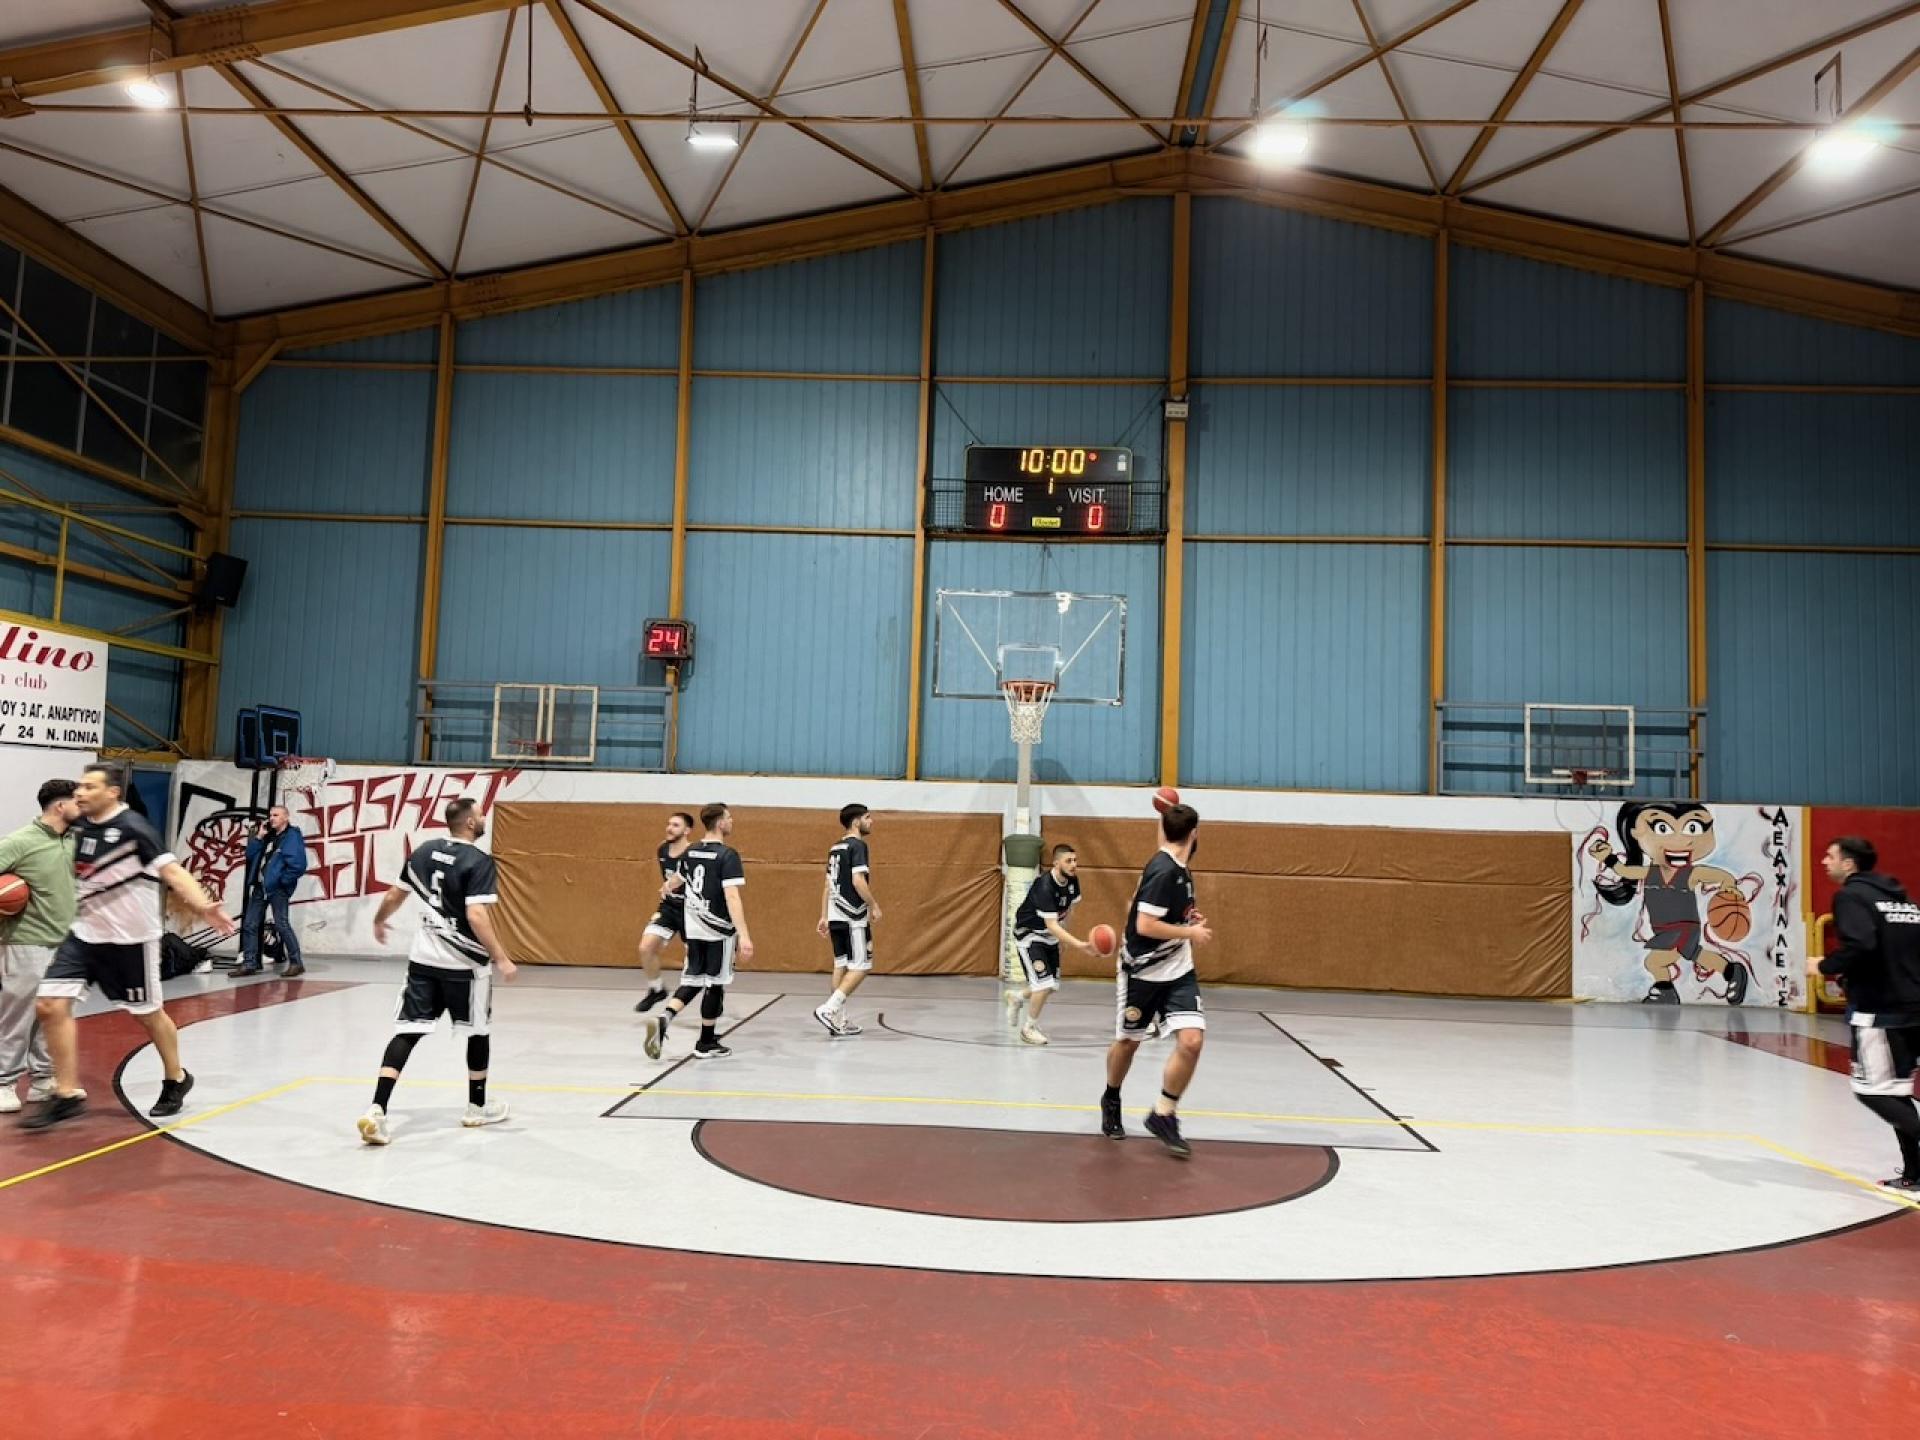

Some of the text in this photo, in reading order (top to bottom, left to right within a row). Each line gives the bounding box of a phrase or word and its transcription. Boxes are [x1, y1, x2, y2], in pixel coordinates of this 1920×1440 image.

[1020, 449, 1085, 474] 10:00
[984, 486, 1024, 503] HOME
[989, 503, 1005, 528] 0
[1088, 505, 1103, 528] 0
[648, 629, 680, 652] 24
[14, 672, 47, 689] club
[18, 725, 33, 738] 24
[428, 869, 445, 907] 5
[693, 863, 706, 894] 8
[126, 986, 144, 1002] 11
